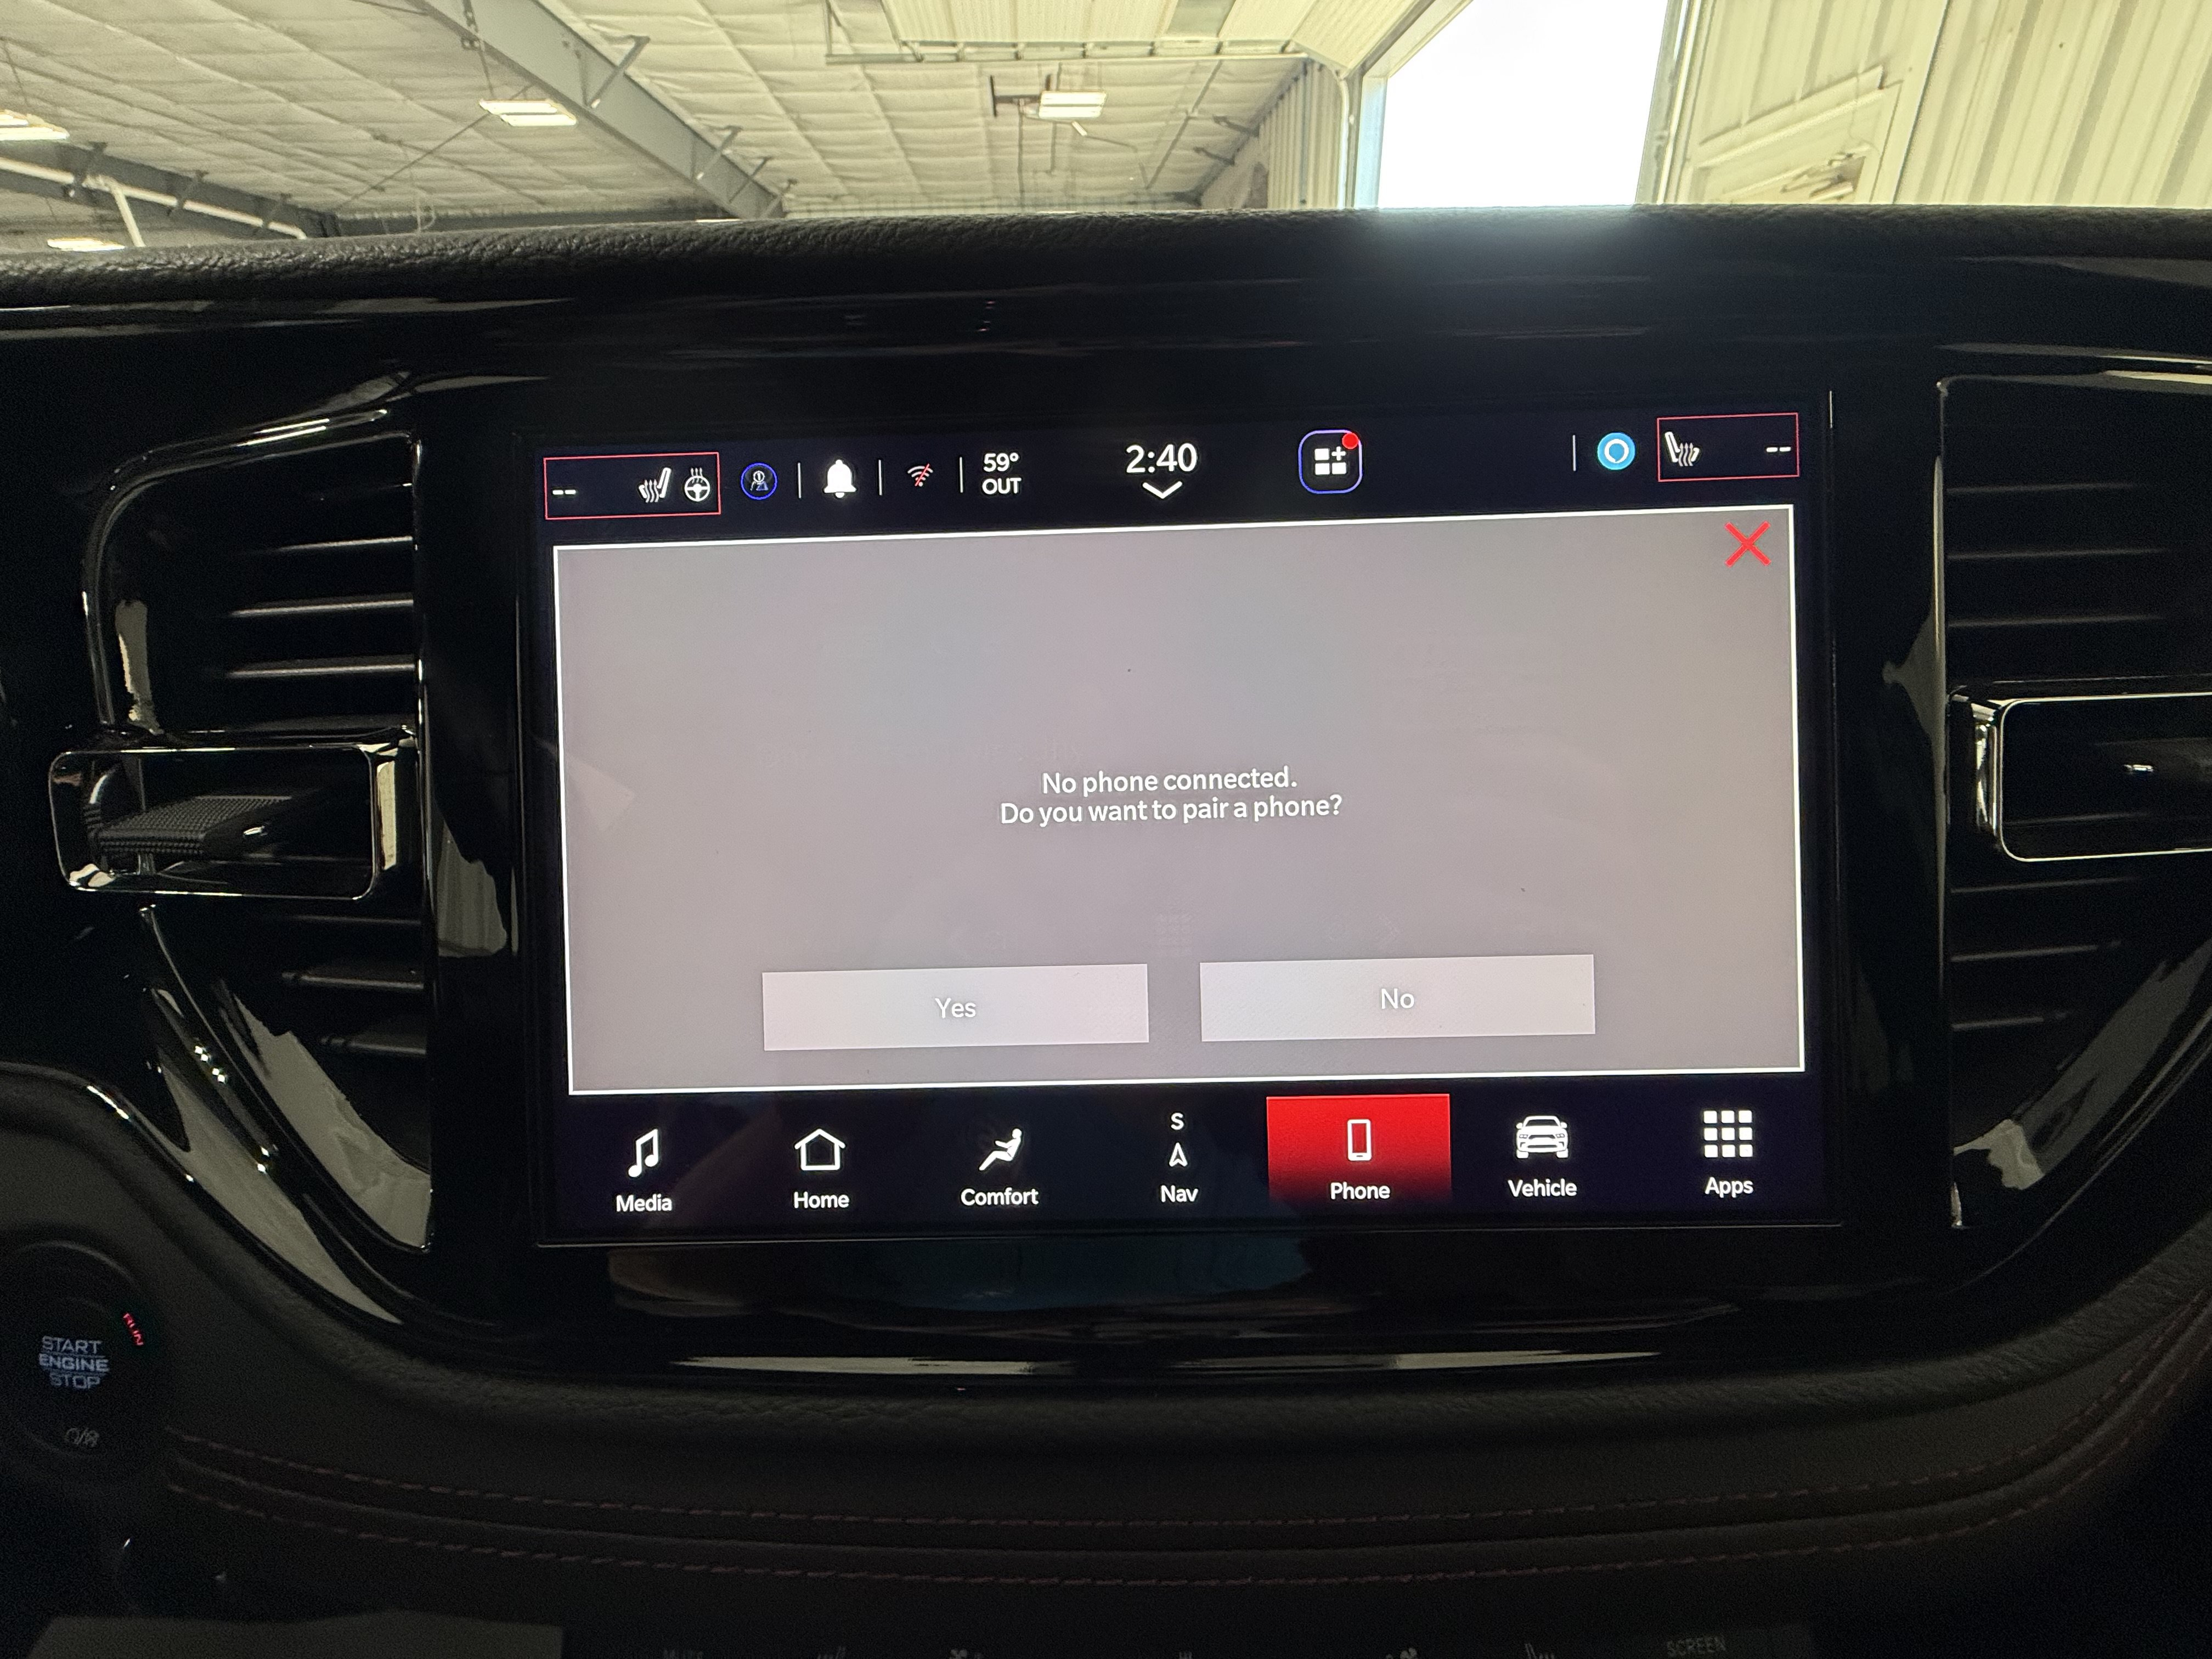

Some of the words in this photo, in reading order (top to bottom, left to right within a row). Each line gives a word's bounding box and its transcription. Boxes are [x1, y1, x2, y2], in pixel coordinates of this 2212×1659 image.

[983, 452, 1019, 472] 59°
[1126, 443, 1198, 473] 2:40
[981, 477, 1022, 495] OUT
[1043, 772, 1076, 794] No
[1083, 770, 1158, 798] phone
[1163, 765, 1298, 791] connected.
[1001, 803, 1034, 824] Do
[1039, 806, 1082, 827] you
[1088, 800, 1148, 821] want
[1152, 800, 1176, 820] to
[1183, 797, 1229, 824] pair
[1234, 802, 1247, 818] a
[1254, 794, 1342, 822] phone?
[934, 997, 977, 1019] Yes
[1379, 988, 1415, 1009] No
[1171, 1113, 1184, 1130] S
[961, 1187, 1039, 1206] Comfort
[1161, 1185, 1199, 1203] Nav
[1330, 1181, 1390, 1200] Phone
[1508, 1178, 1577, 1197] Vehicle
[1705, 1176, 1754, 1198] Apps
[616, 1193, 673, 1212] Media
[794, 1191, 850, 1209] Home
[42, 1335, 102, 1355] START
[38, 1353, 110, 1372] ENGINE
[50, 1372, 101, 1389] STOP
